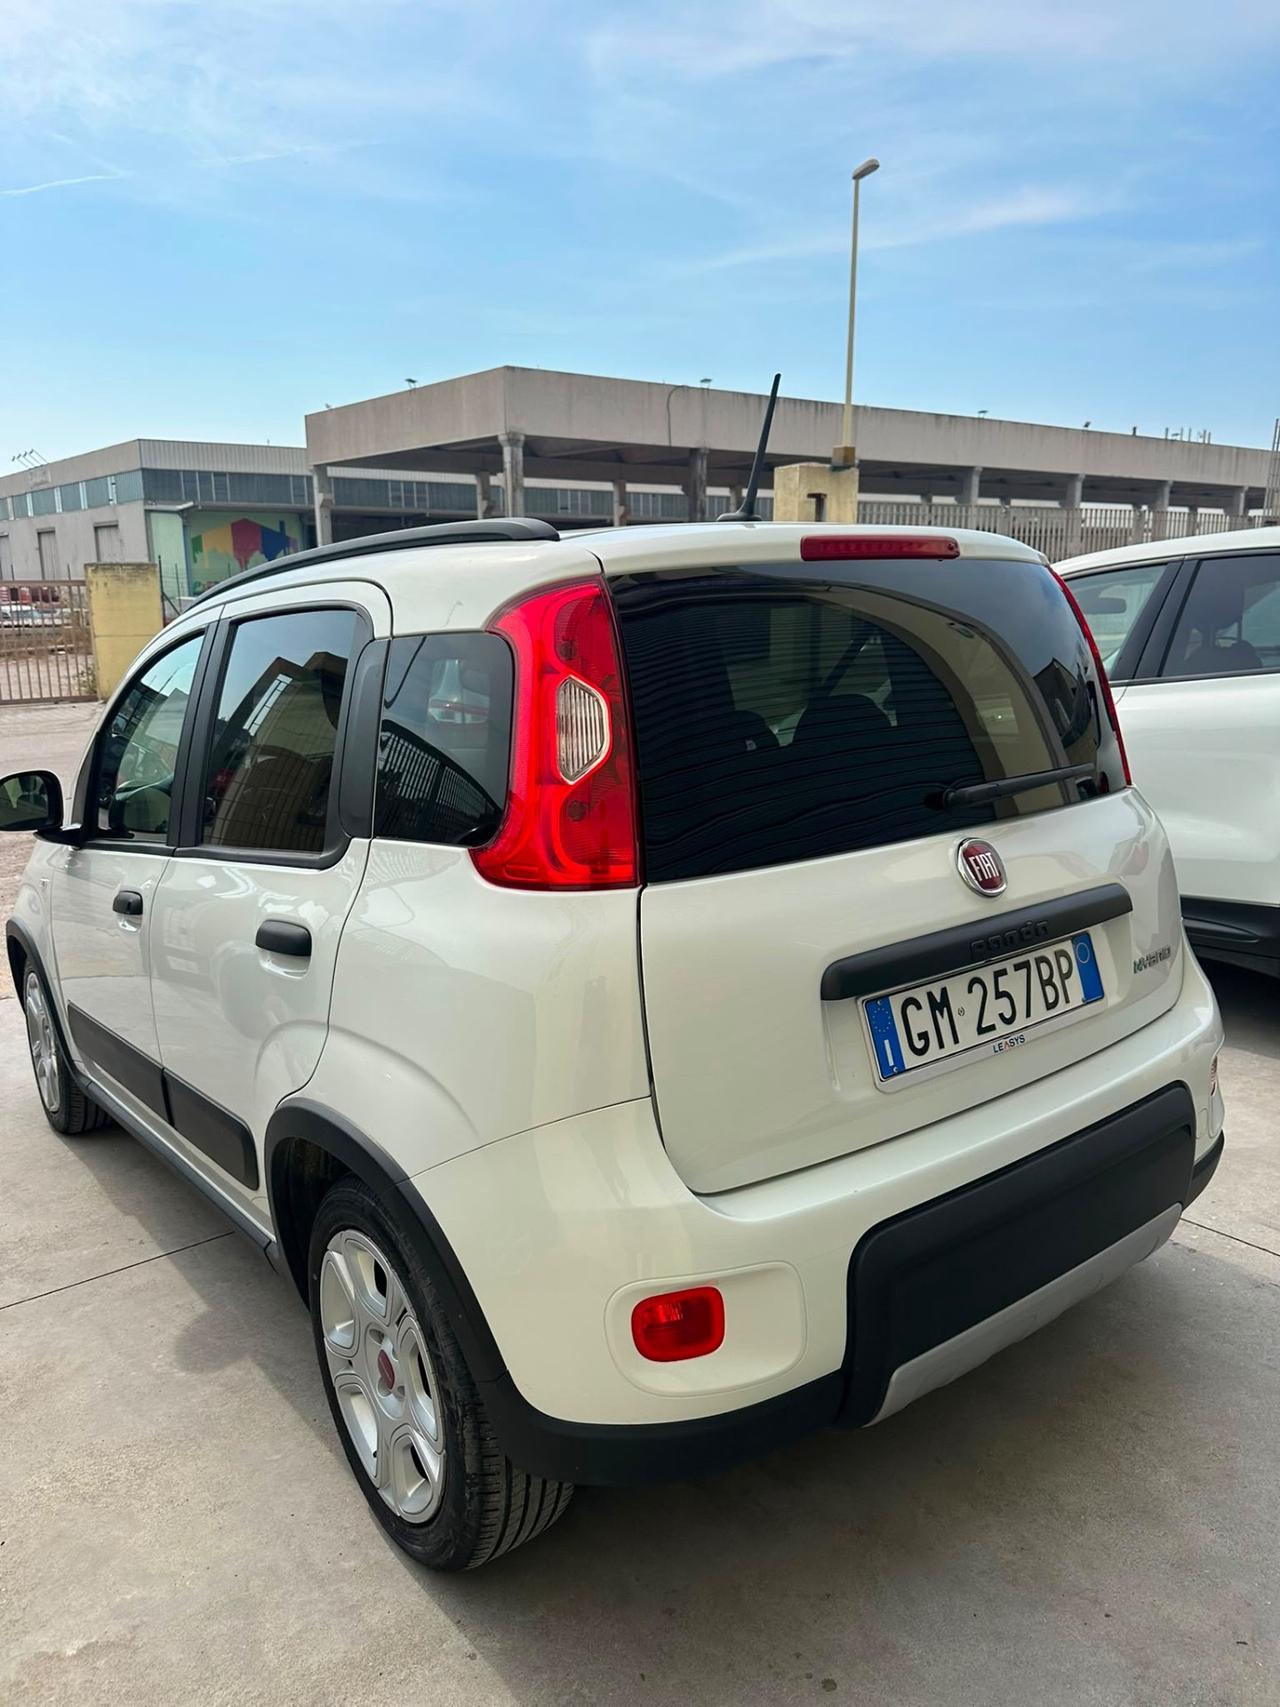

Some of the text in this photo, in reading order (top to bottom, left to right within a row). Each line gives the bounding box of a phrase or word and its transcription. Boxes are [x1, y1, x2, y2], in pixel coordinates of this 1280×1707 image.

[968, 852, 1000, 882] FIAT
[900, 986, 960, 1057] GM
[967, 948, 1074, 1036] 257BP
[992, 1034, 1026, 1054] LEASYS
